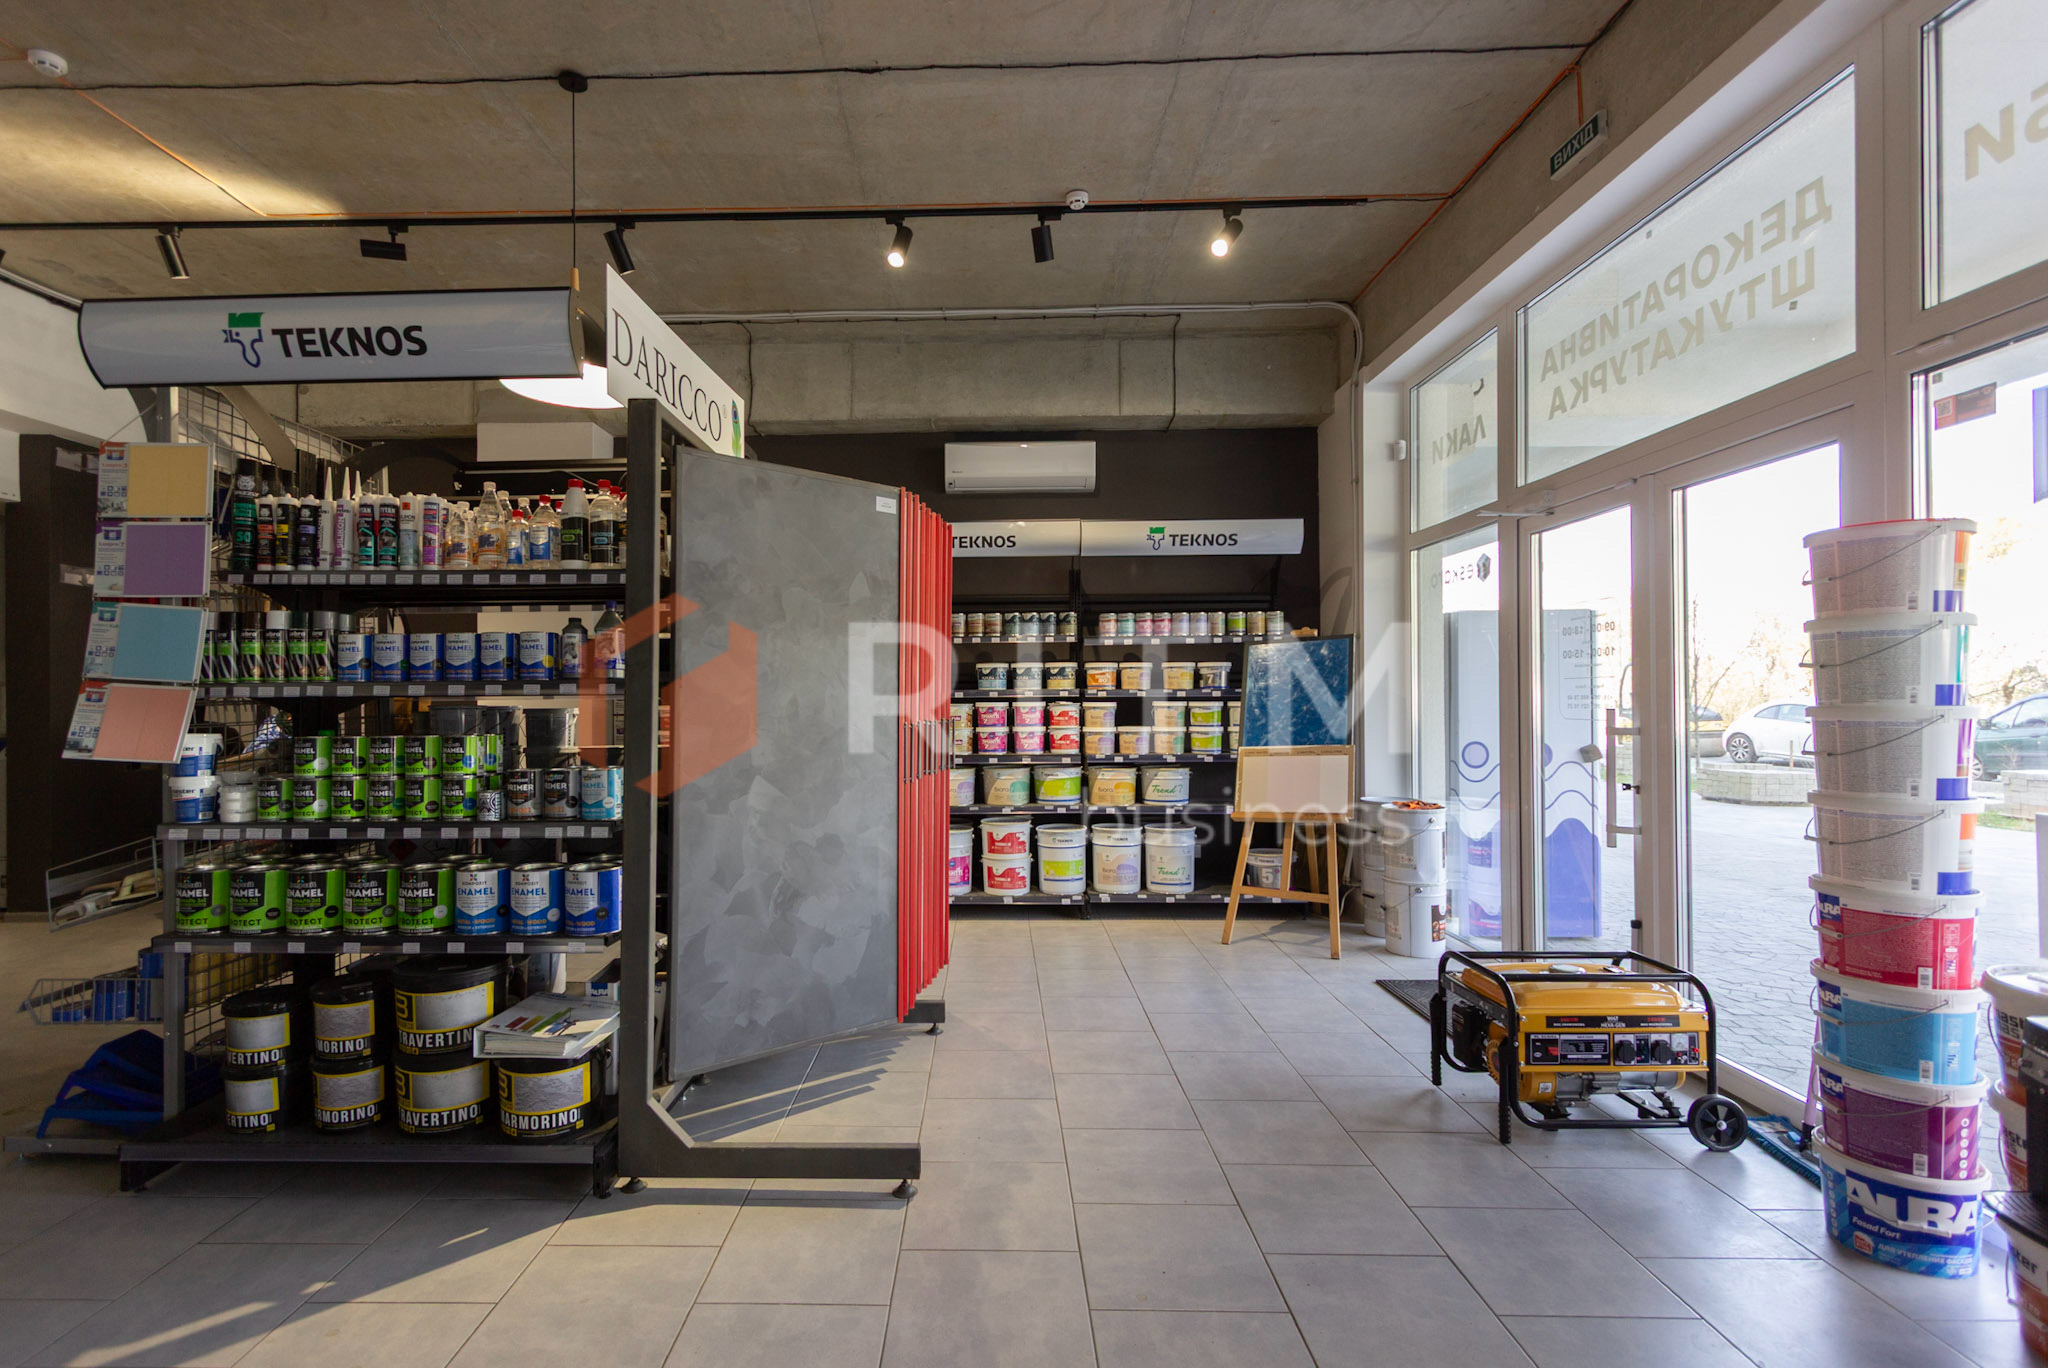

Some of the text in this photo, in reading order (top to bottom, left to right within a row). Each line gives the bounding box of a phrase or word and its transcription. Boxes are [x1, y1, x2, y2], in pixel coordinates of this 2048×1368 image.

[1554, 122, 1595, 170] ВИХІД
[271, 325, 428, 358] TEKNOS
[612, 307, 722, 442] DARICCO
[1169, 533, 1238, 547] TEKNOS
[1206, 673, 1214, 684] 7
[1152, 784, 1177, 795] Trend
[1157, 866, 1180, 876] Trend
[1261, 868, 1274, 883] 5
[346, 888, 385, 898] ENAMEL
[399, 888, 436, 898] ENAMEL
[458, 888, 495, 897] ENAMEL
[512, 888, 547, 897] ENAMEL
[399, 1027, 474, 1049] TRAVERTIN
[316, 1038, 365, 1054] MORINO
[227, 1049, 281, 1065] VERTINO
[227, 1113, 269, 1129] ERTINO
[315, 1104, 375, 1124] RMORINO
[1852, 1216, 1901, 1240] Fasad Fort
